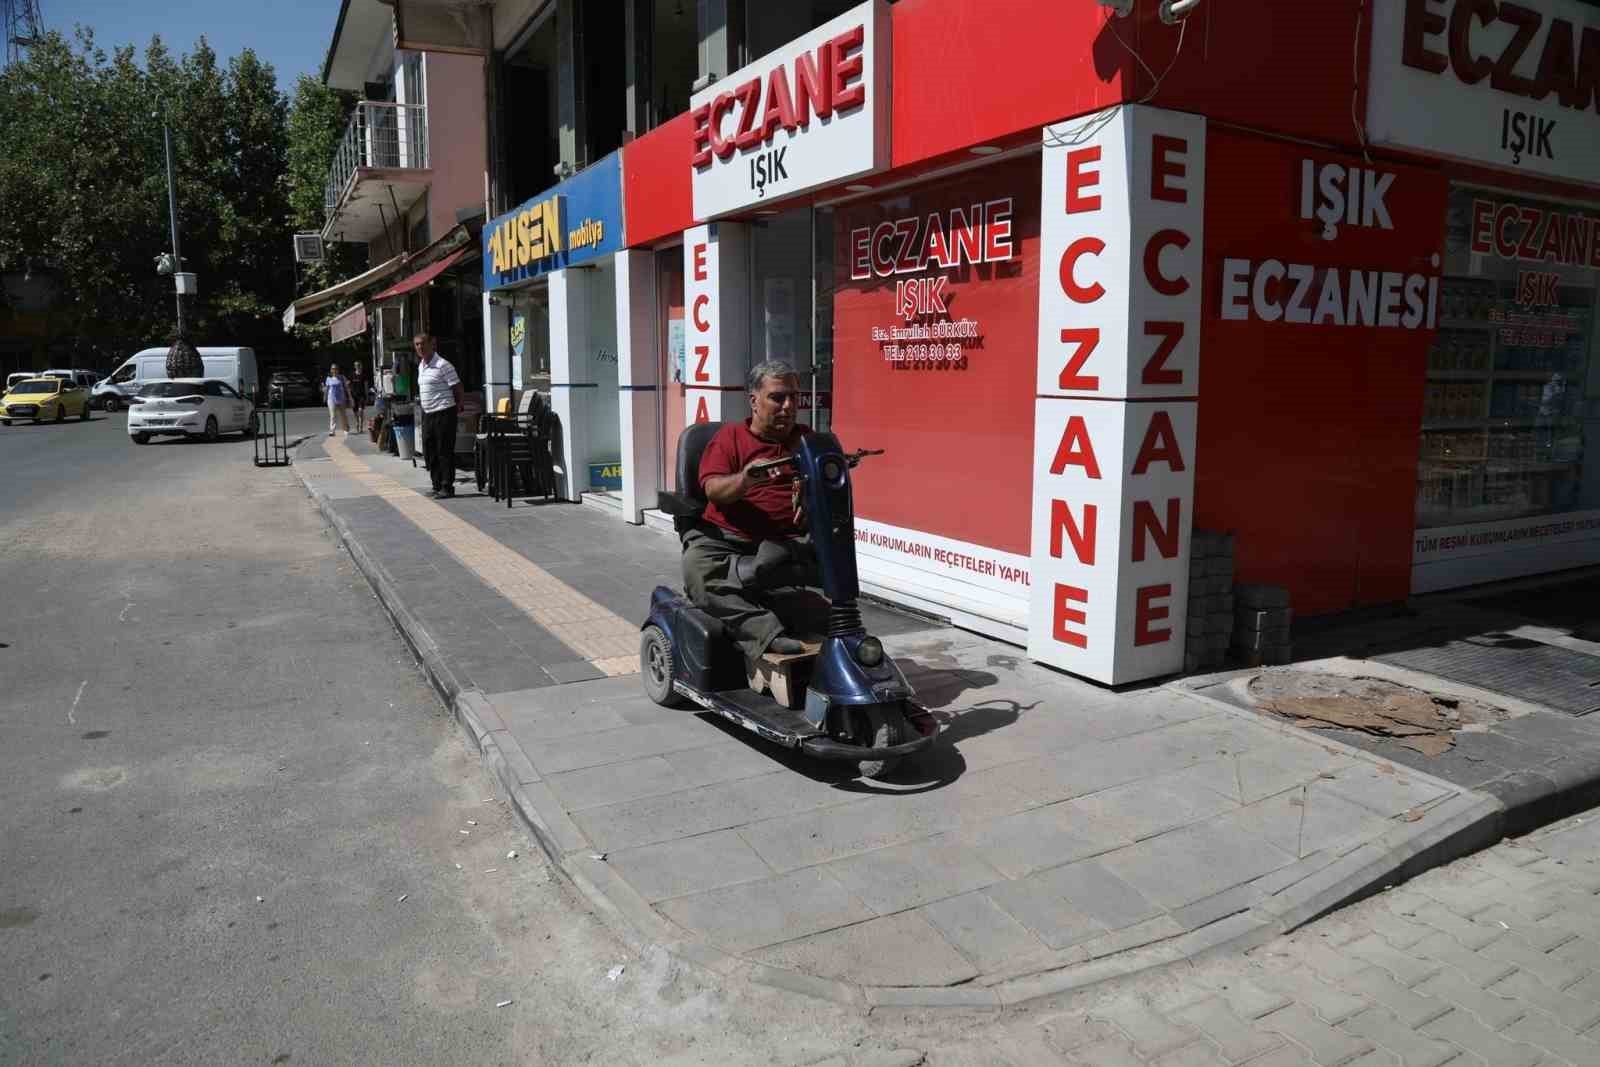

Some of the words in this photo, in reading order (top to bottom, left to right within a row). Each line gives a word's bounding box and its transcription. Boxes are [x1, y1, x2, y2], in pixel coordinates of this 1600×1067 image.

[692, 23, 865, 170] ECZANE
[750, 146, 788, 197] IŞIK
[1501, 108, 1557, 165] IŞIK
[488, 193, 560, 275] AHSEN
[569, 217, 603, 249] mobilya
[851, 197, 1013, 280] ECZANE
[1301, 158, 1397, 241] IŞIK
[896, 276, 948, 320] IŞIK
[1220, 252, 1440, 329] ECZANESİ
[906, 344, 927, 360] 213
[929, 344, 945, 360] 30
[946, 344, 961, 360] 33
[1131, 134, 1190, 647] ECZANE
[1049, 145, 1106, 649] ECZANE
[870, 532, 931, 559] KURUMLARIN
